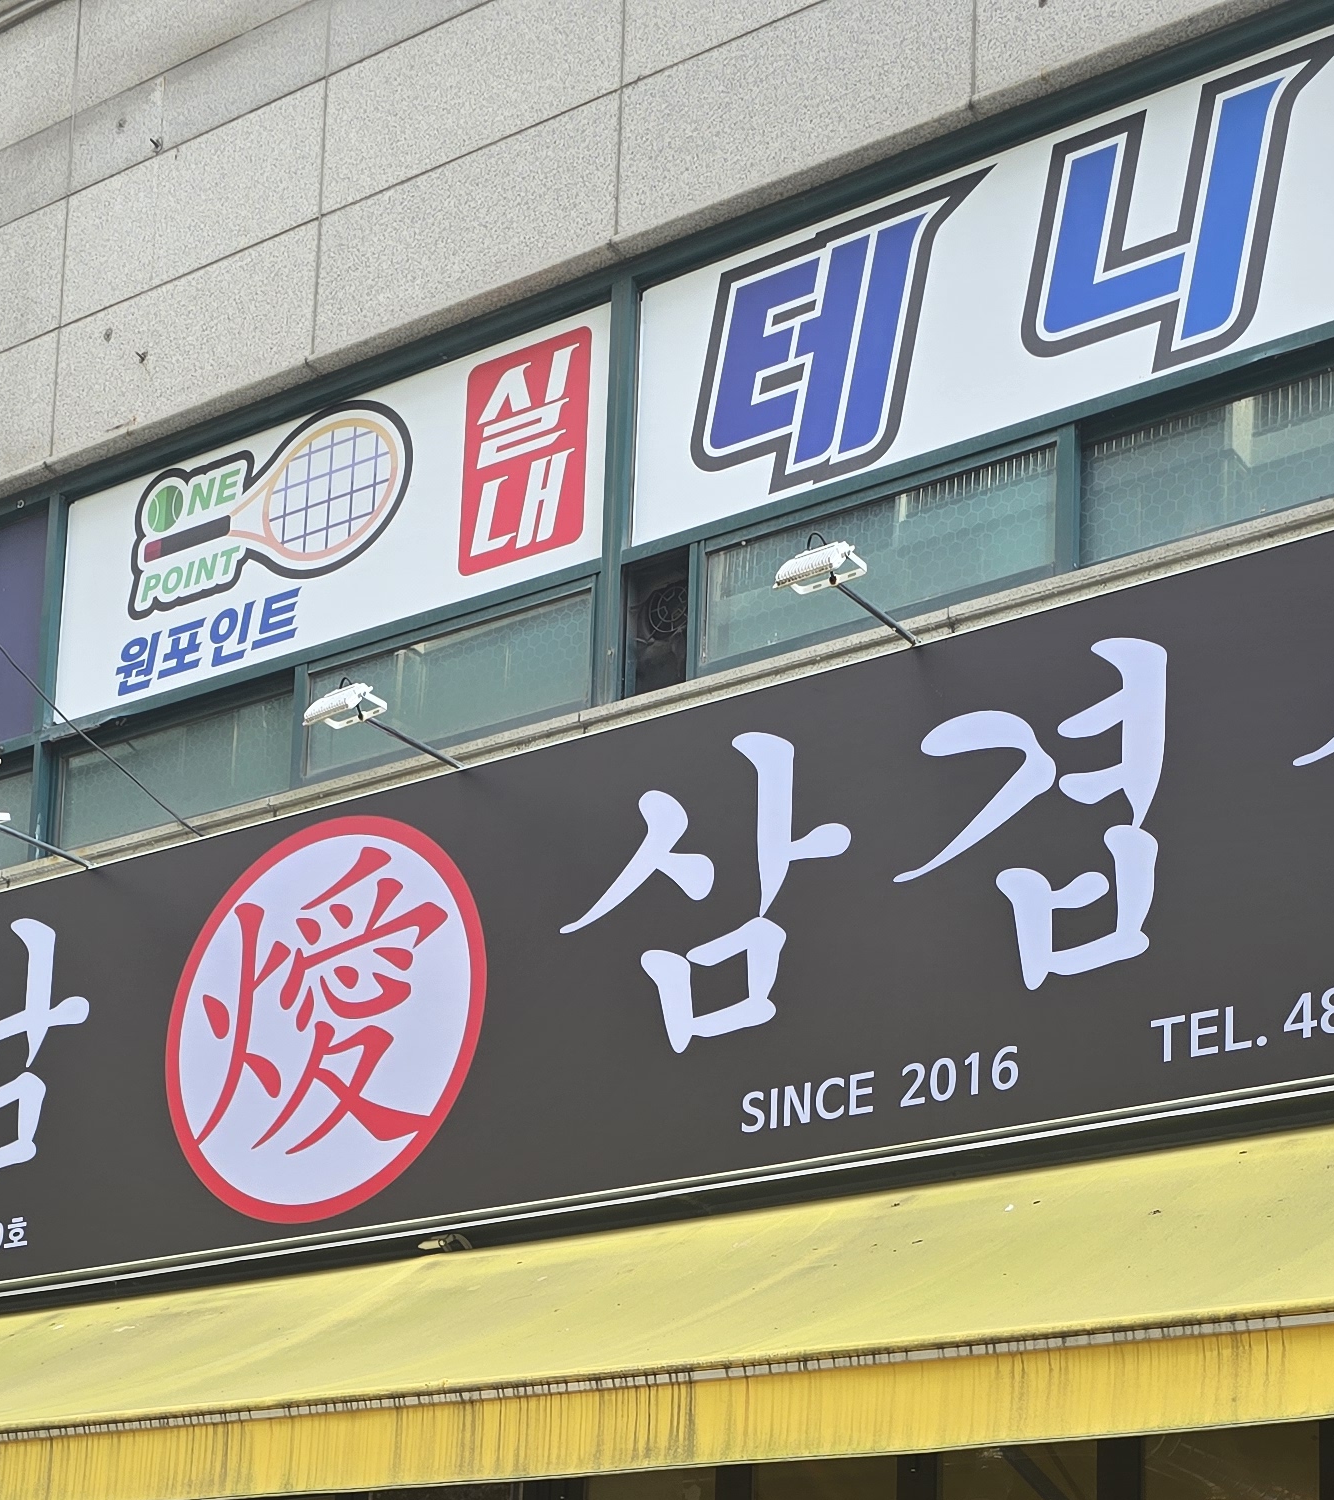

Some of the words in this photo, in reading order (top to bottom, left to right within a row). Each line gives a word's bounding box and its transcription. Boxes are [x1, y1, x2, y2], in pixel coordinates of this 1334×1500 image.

[467, 343, 579, 555] 실내
[140, 545, 241, 601] POINT
[117, 587, 302, 697] 원포인트
[1150, 1004, 1270, 1063] TEL.
[740, 1069, 874, 1134] SINCE
[899, 1045, 1020, 1110] 2016
